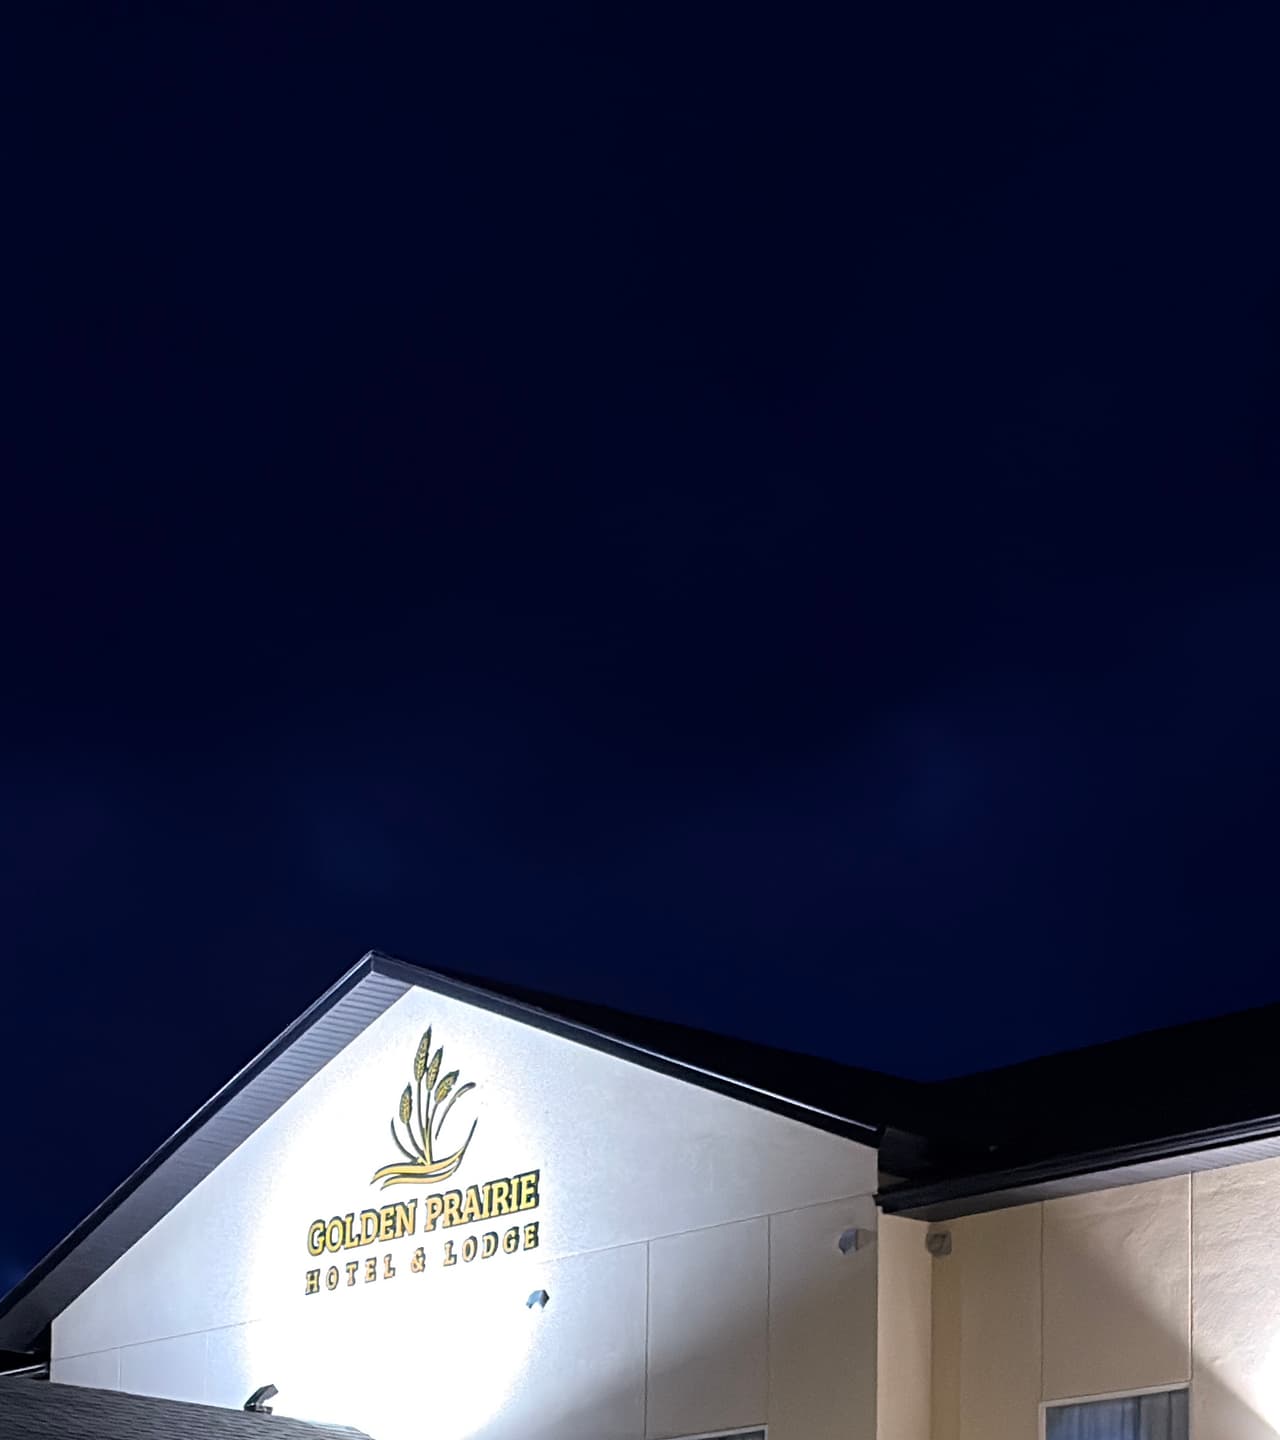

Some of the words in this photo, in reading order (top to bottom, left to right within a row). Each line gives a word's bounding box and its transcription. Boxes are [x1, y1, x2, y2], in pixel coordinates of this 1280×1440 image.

[307, 1199, 417, 1256] GOLDEN
[425, 1170, 540, 1231] PRAIRIE
[305, 1254, 396, 1295] HOTEL
[411, 1247, 426, 1273] &
[443, 1222, 539, 1266] LODGE
